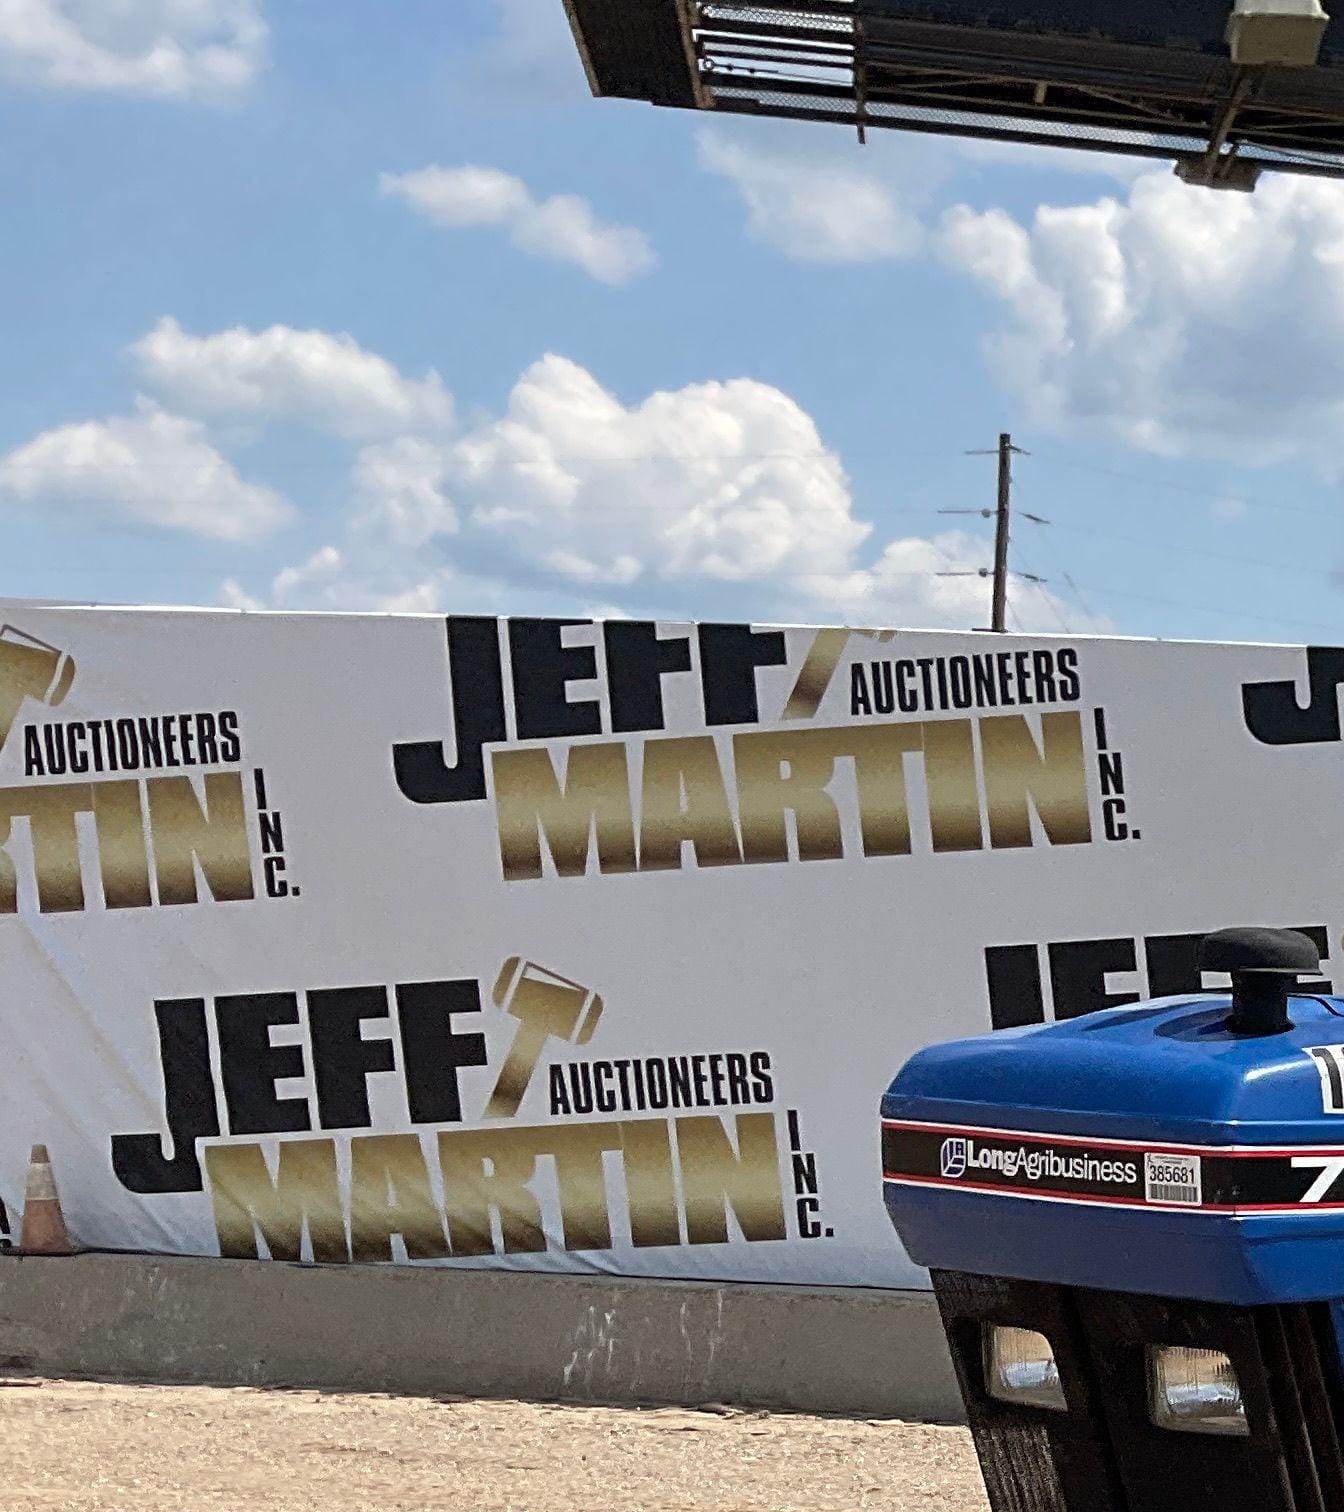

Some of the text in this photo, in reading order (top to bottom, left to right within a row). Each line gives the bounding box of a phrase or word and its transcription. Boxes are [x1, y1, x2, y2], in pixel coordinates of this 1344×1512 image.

[24, 711, 241, 776] AUCTIONEERS
[392, 615, 787, 803] JEFF
[850, 648, 1081, 716] AUCTIONEERS
[253, 767, 301, 898] INC.
[492, 708, 1092, 882] MARTIN
[1094, 706, 1141, 842] INC.
[111, 979, 488, 1193] JEFF
[548, 1052, 775, 1115] AUCTIONEERS
[204, 1111, 787, 1263] MARTIN
[787, 1109, 835, 1239] INC.
[1149, 1164, 1195, 1184] 385681
